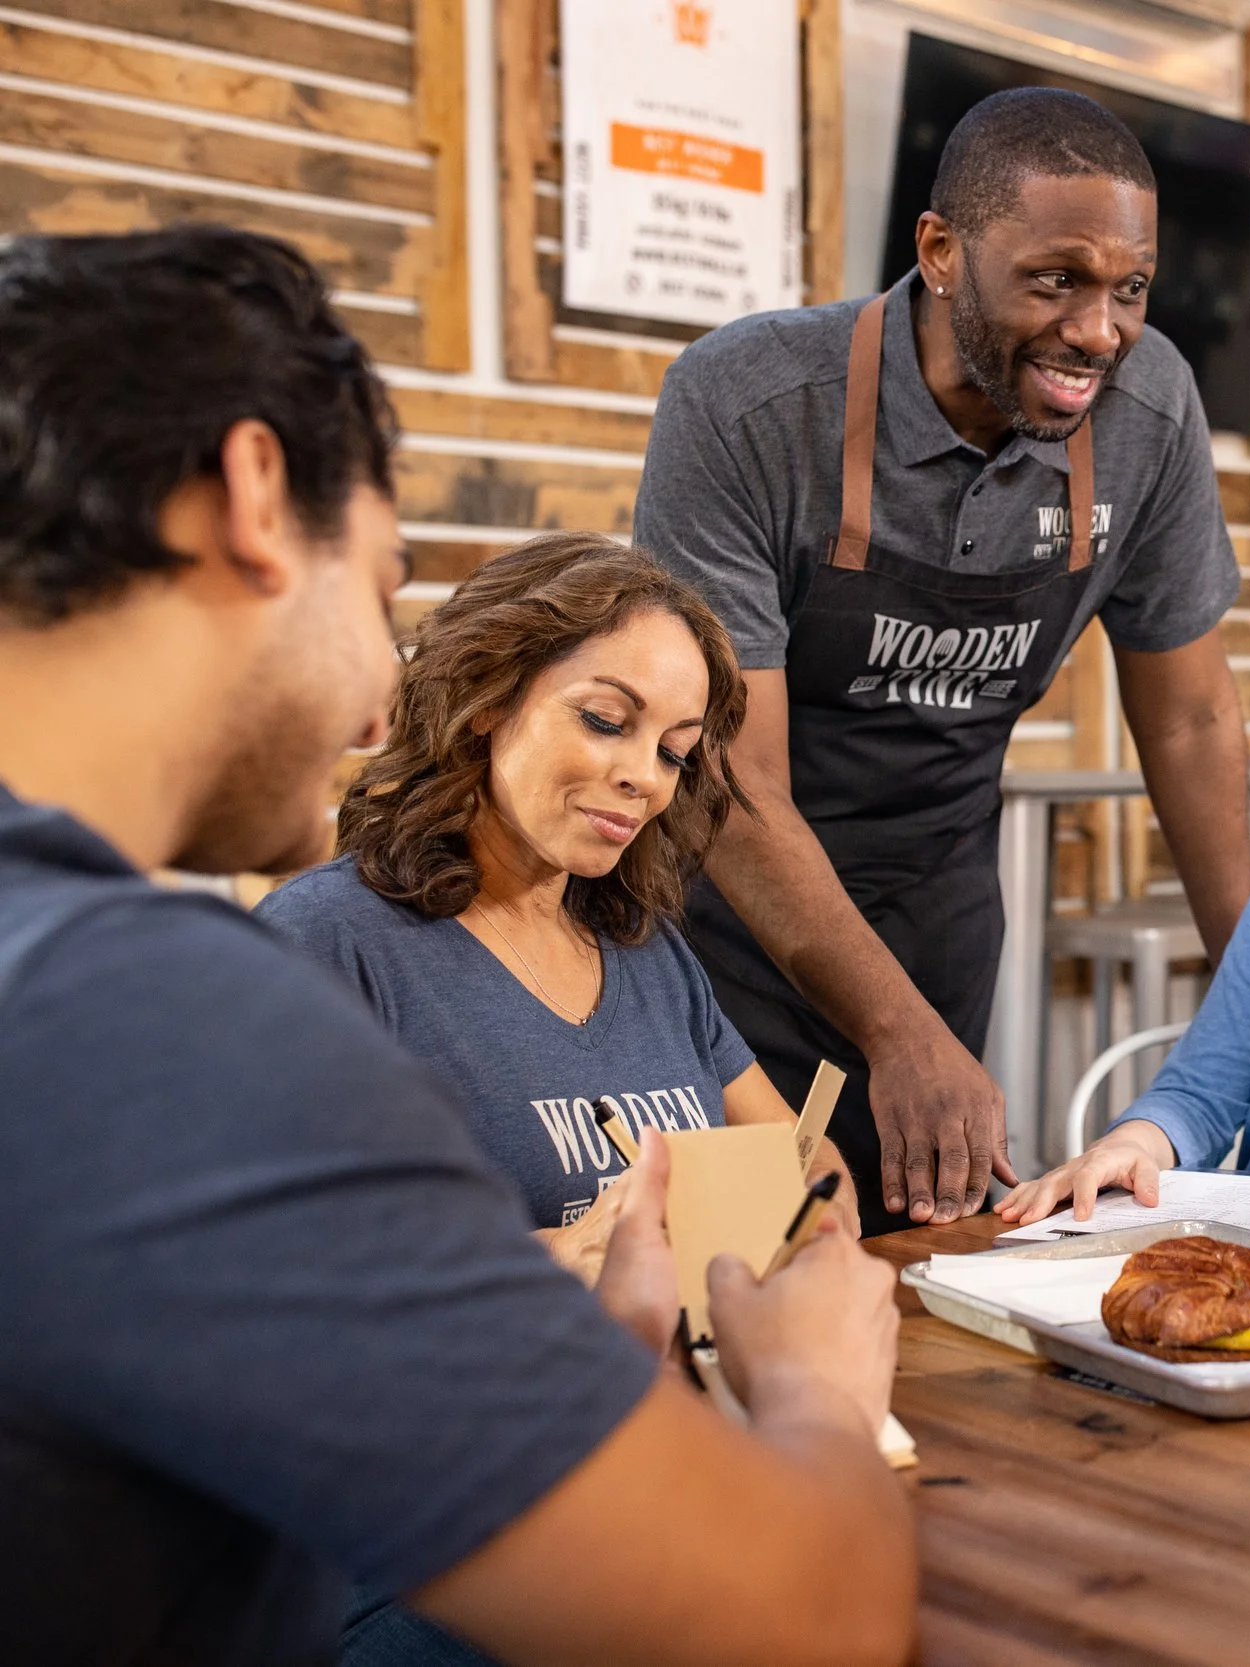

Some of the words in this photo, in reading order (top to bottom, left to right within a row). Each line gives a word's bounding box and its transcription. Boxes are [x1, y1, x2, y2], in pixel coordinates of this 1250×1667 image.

[1037, 504, 1113, 537] WOEN
[867, 613, 1041, 672] WOODEN
[886, 669, 989, 710] TINE
